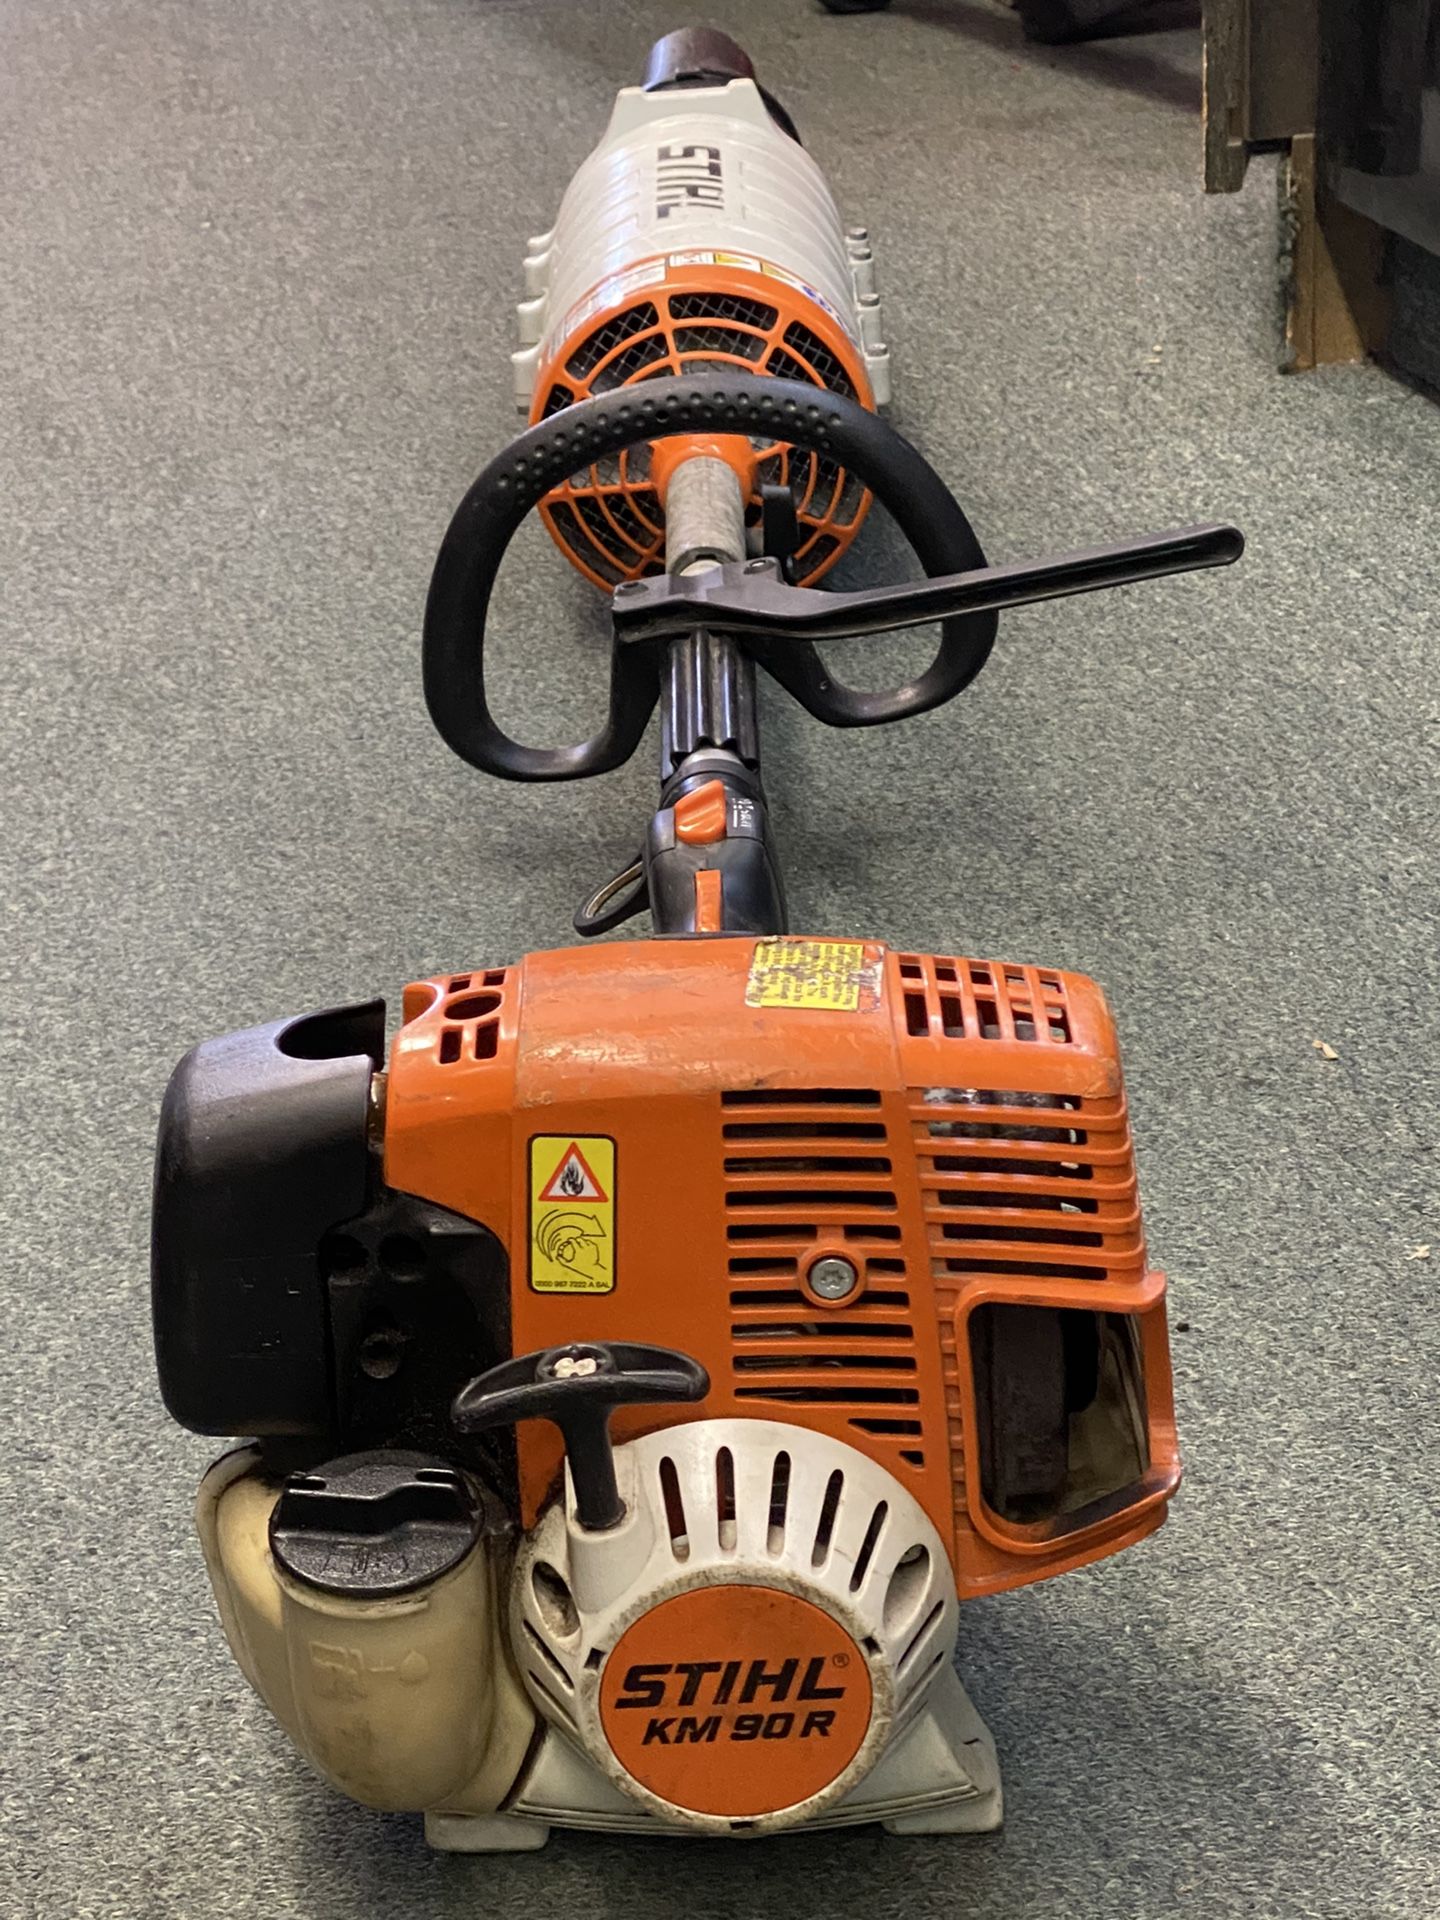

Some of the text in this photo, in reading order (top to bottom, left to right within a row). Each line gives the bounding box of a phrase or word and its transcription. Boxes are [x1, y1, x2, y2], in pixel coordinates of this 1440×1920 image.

[657, 145, 724, 219] STIHL
[641, 1710, 836, 1745] KM 90 R
